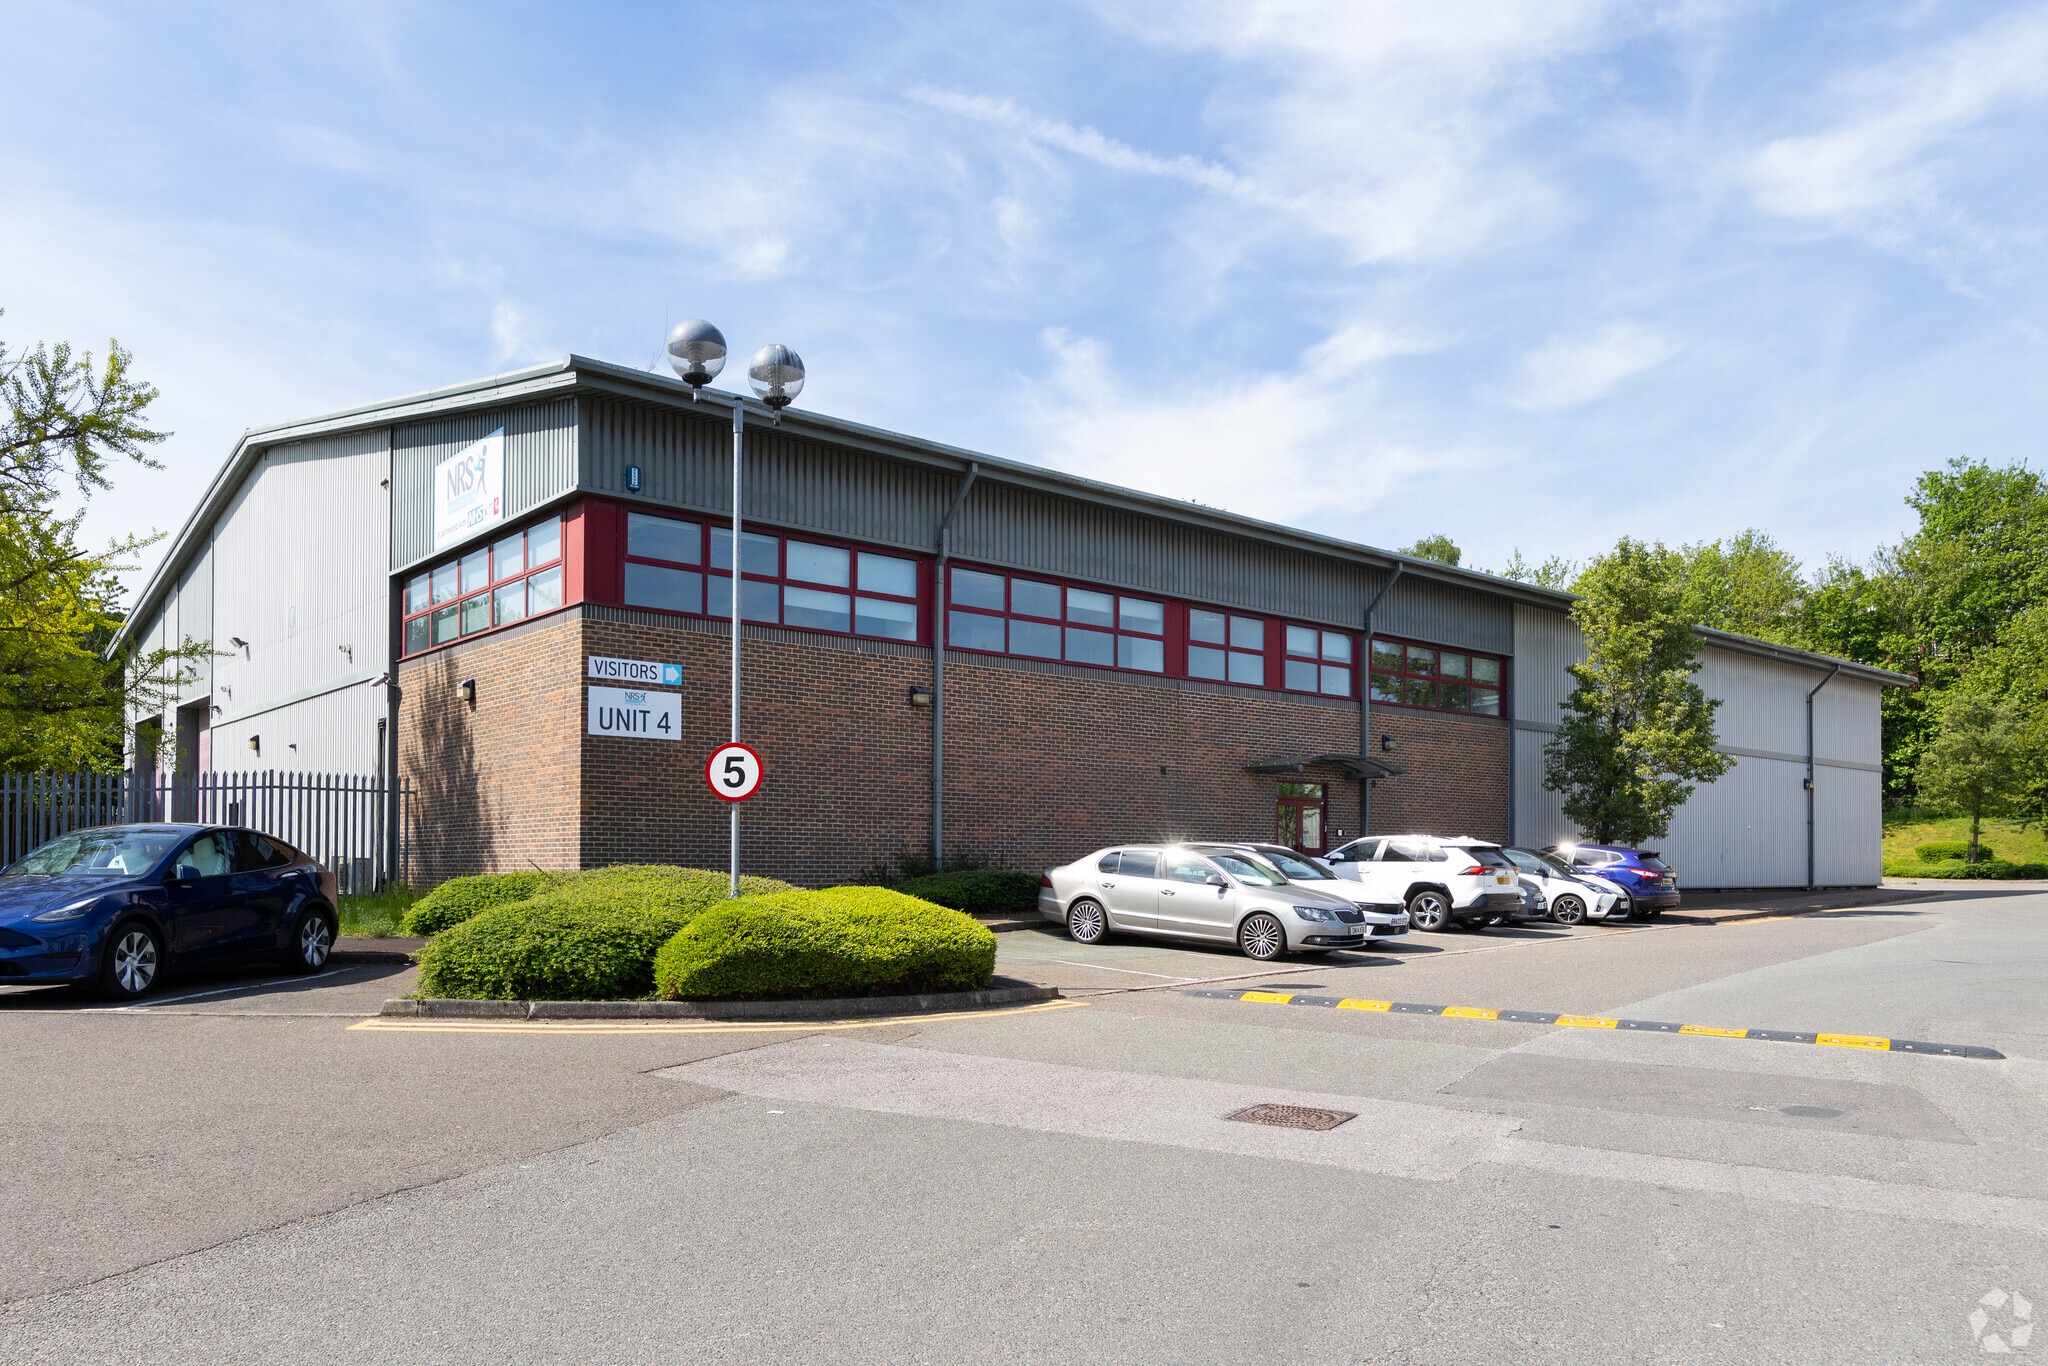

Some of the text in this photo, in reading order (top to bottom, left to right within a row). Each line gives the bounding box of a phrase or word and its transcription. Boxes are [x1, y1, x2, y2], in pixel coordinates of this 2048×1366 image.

[447, 455, 474, 501] NRS
[594, 659, 658, 680] VISITORS
[625, 691, 640, 700] NRS
[599, 706, 671, 734] UNIT 4
[723, 756, 746, 788] 5
